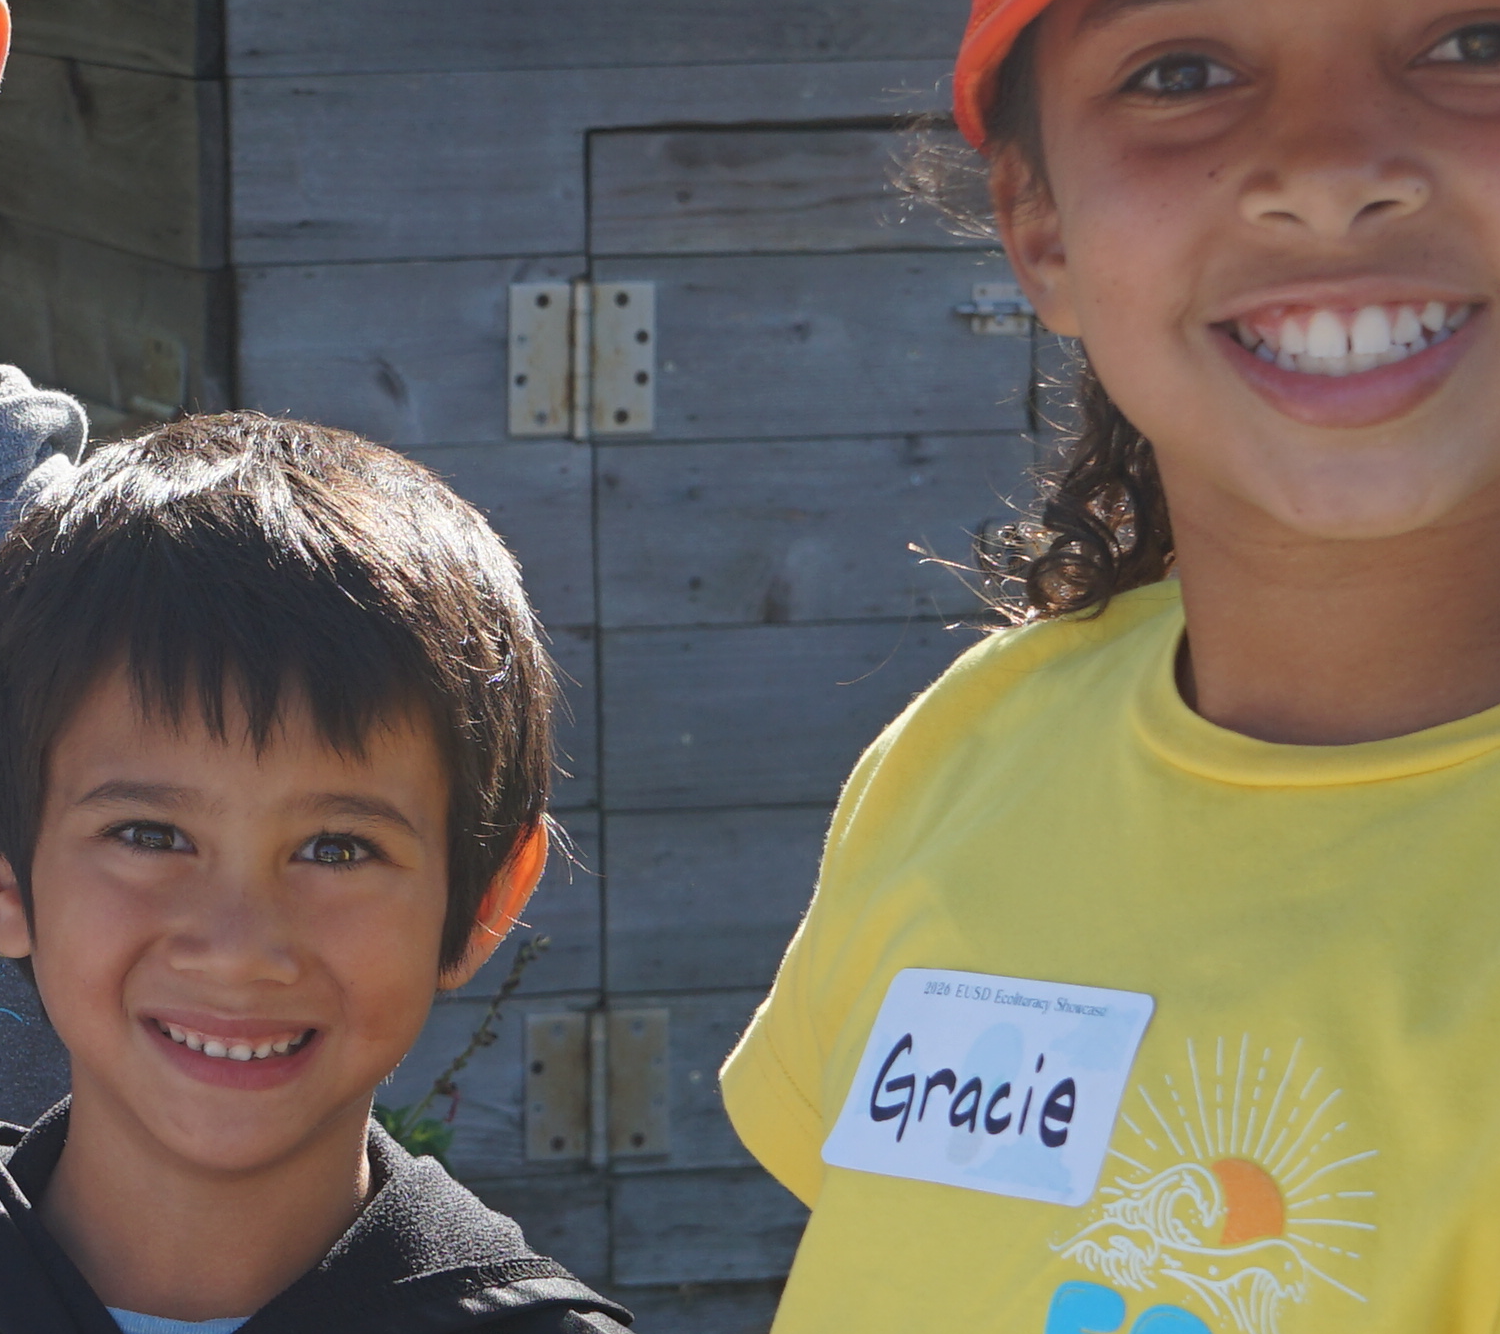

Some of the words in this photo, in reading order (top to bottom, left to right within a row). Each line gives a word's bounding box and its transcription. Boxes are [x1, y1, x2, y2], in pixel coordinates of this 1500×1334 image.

[923, 980, 951, 996] 2026
[955, 983, 992, 1001] EUSD
[994, 989, 1051, 1015] Ecoliteracy
[1053, 996, 1108, 1018] Showcase
[869, 1032, 1077, 1149] Gracie
